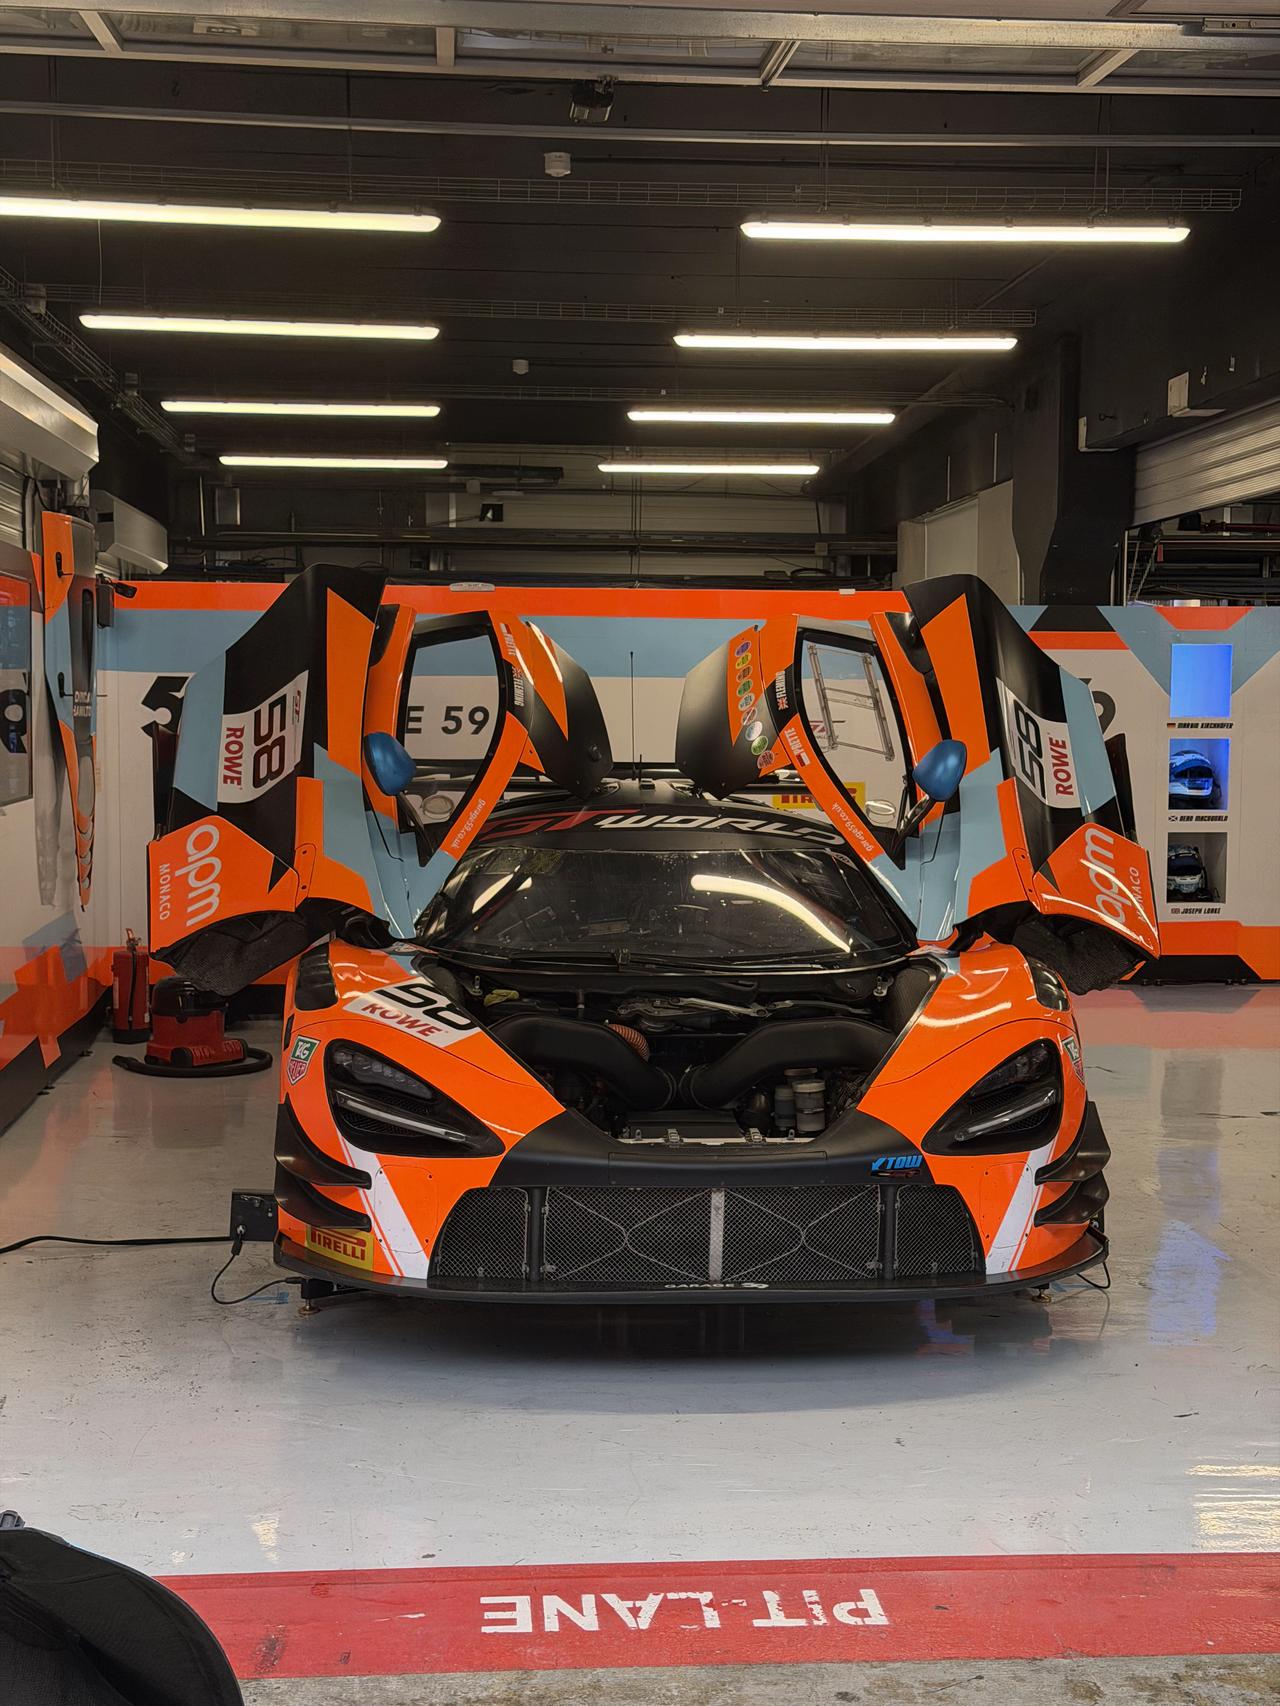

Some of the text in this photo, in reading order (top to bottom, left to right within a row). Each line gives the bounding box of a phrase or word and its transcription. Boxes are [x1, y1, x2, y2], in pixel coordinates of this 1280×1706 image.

[513, 676, 525, 707] FLEMING
[775, 670, 787, 698] FLEMING
[252, 693, 287, 789] 58
[441, 705, 490, 735] 59
[222, 725, 246, 786] ROWE
[1013, 699, 1047, 800] 58
[1048, 736, 1075, 796] ROWE
[451, 797, 487, 849] garage59.co.uk
[594, 814, 847, 846] WORLD
[831, 801, 875, 852] garage59.co.uk
[159, 863, 171, 921] MONACO
[361, 1003, 443, 1038] ROWE
[885, 1154, 923, 1170] TOW
[310, 1227, 367, 1262] PIRELLI
